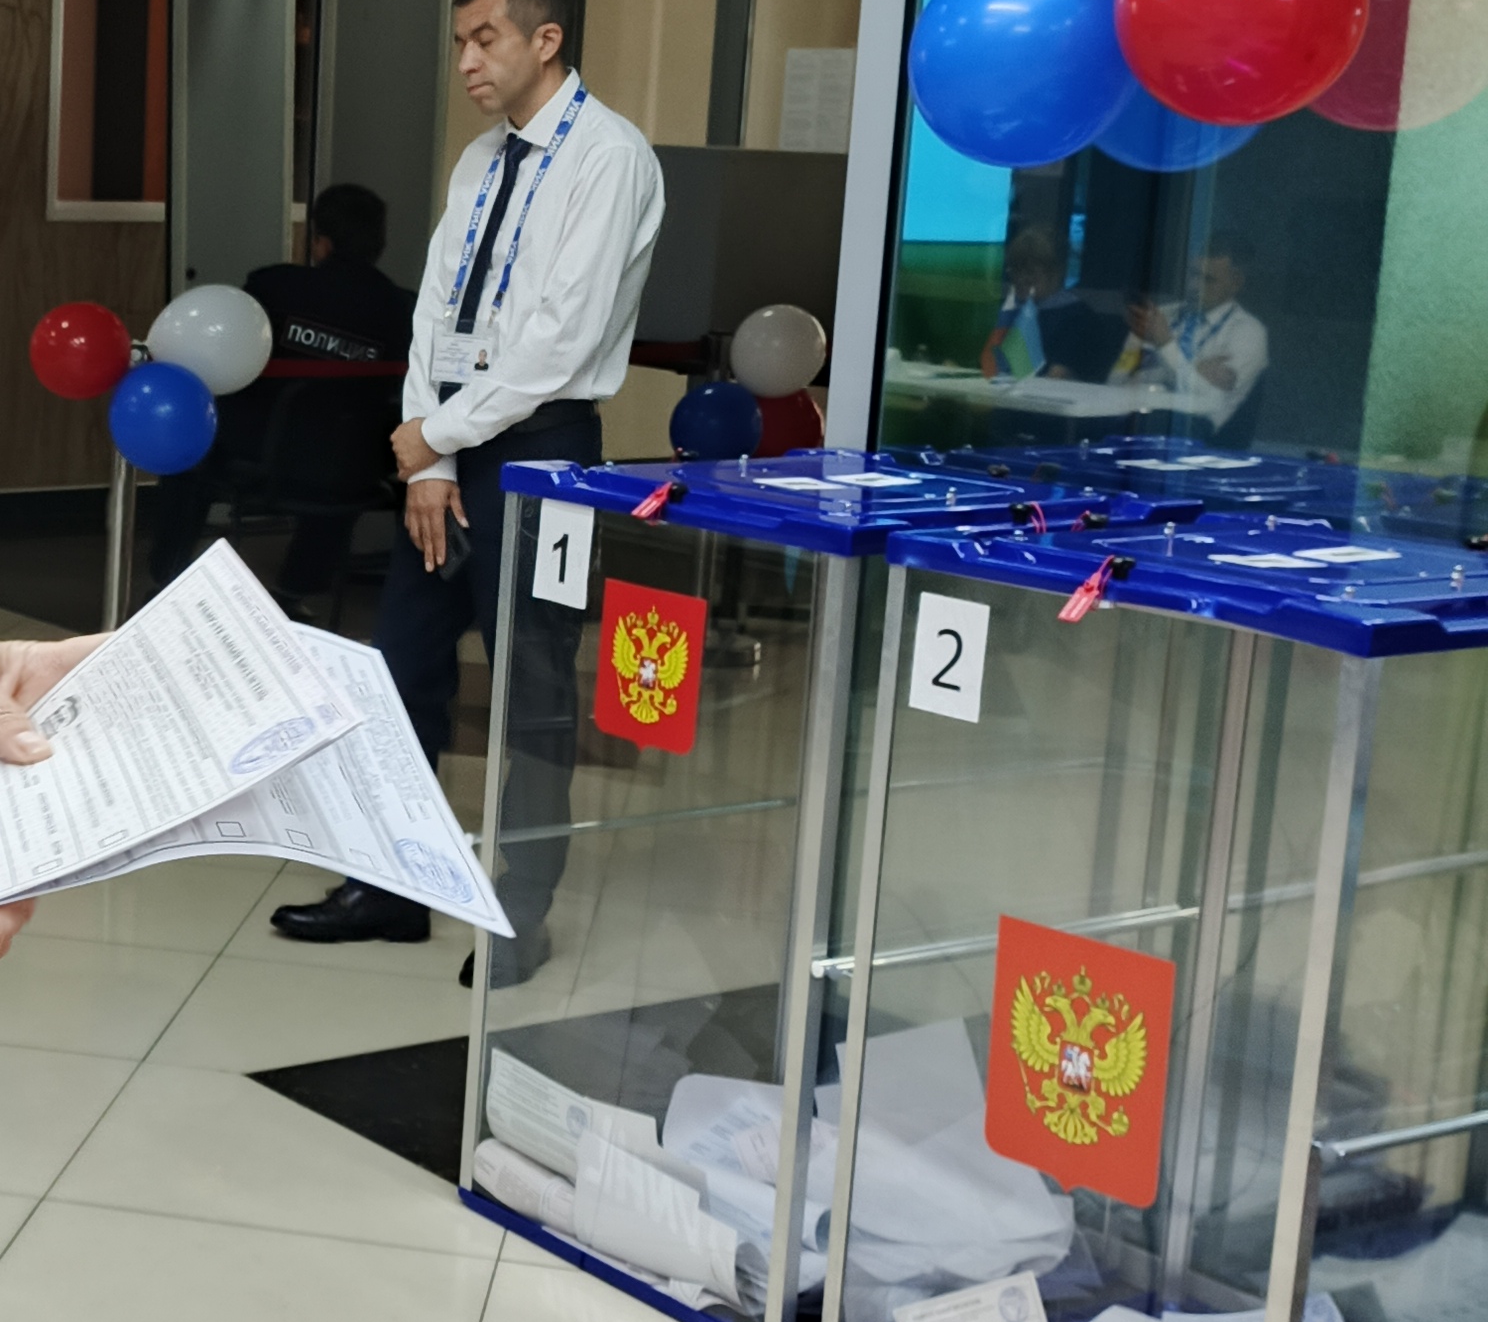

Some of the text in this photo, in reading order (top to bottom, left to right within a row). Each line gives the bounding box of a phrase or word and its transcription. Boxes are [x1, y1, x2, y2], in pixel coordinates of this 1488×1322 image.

[562, 100, 580, 124] УИК
[553, 533, 569, 584] 1
[932, 629, 963, 691] 2
